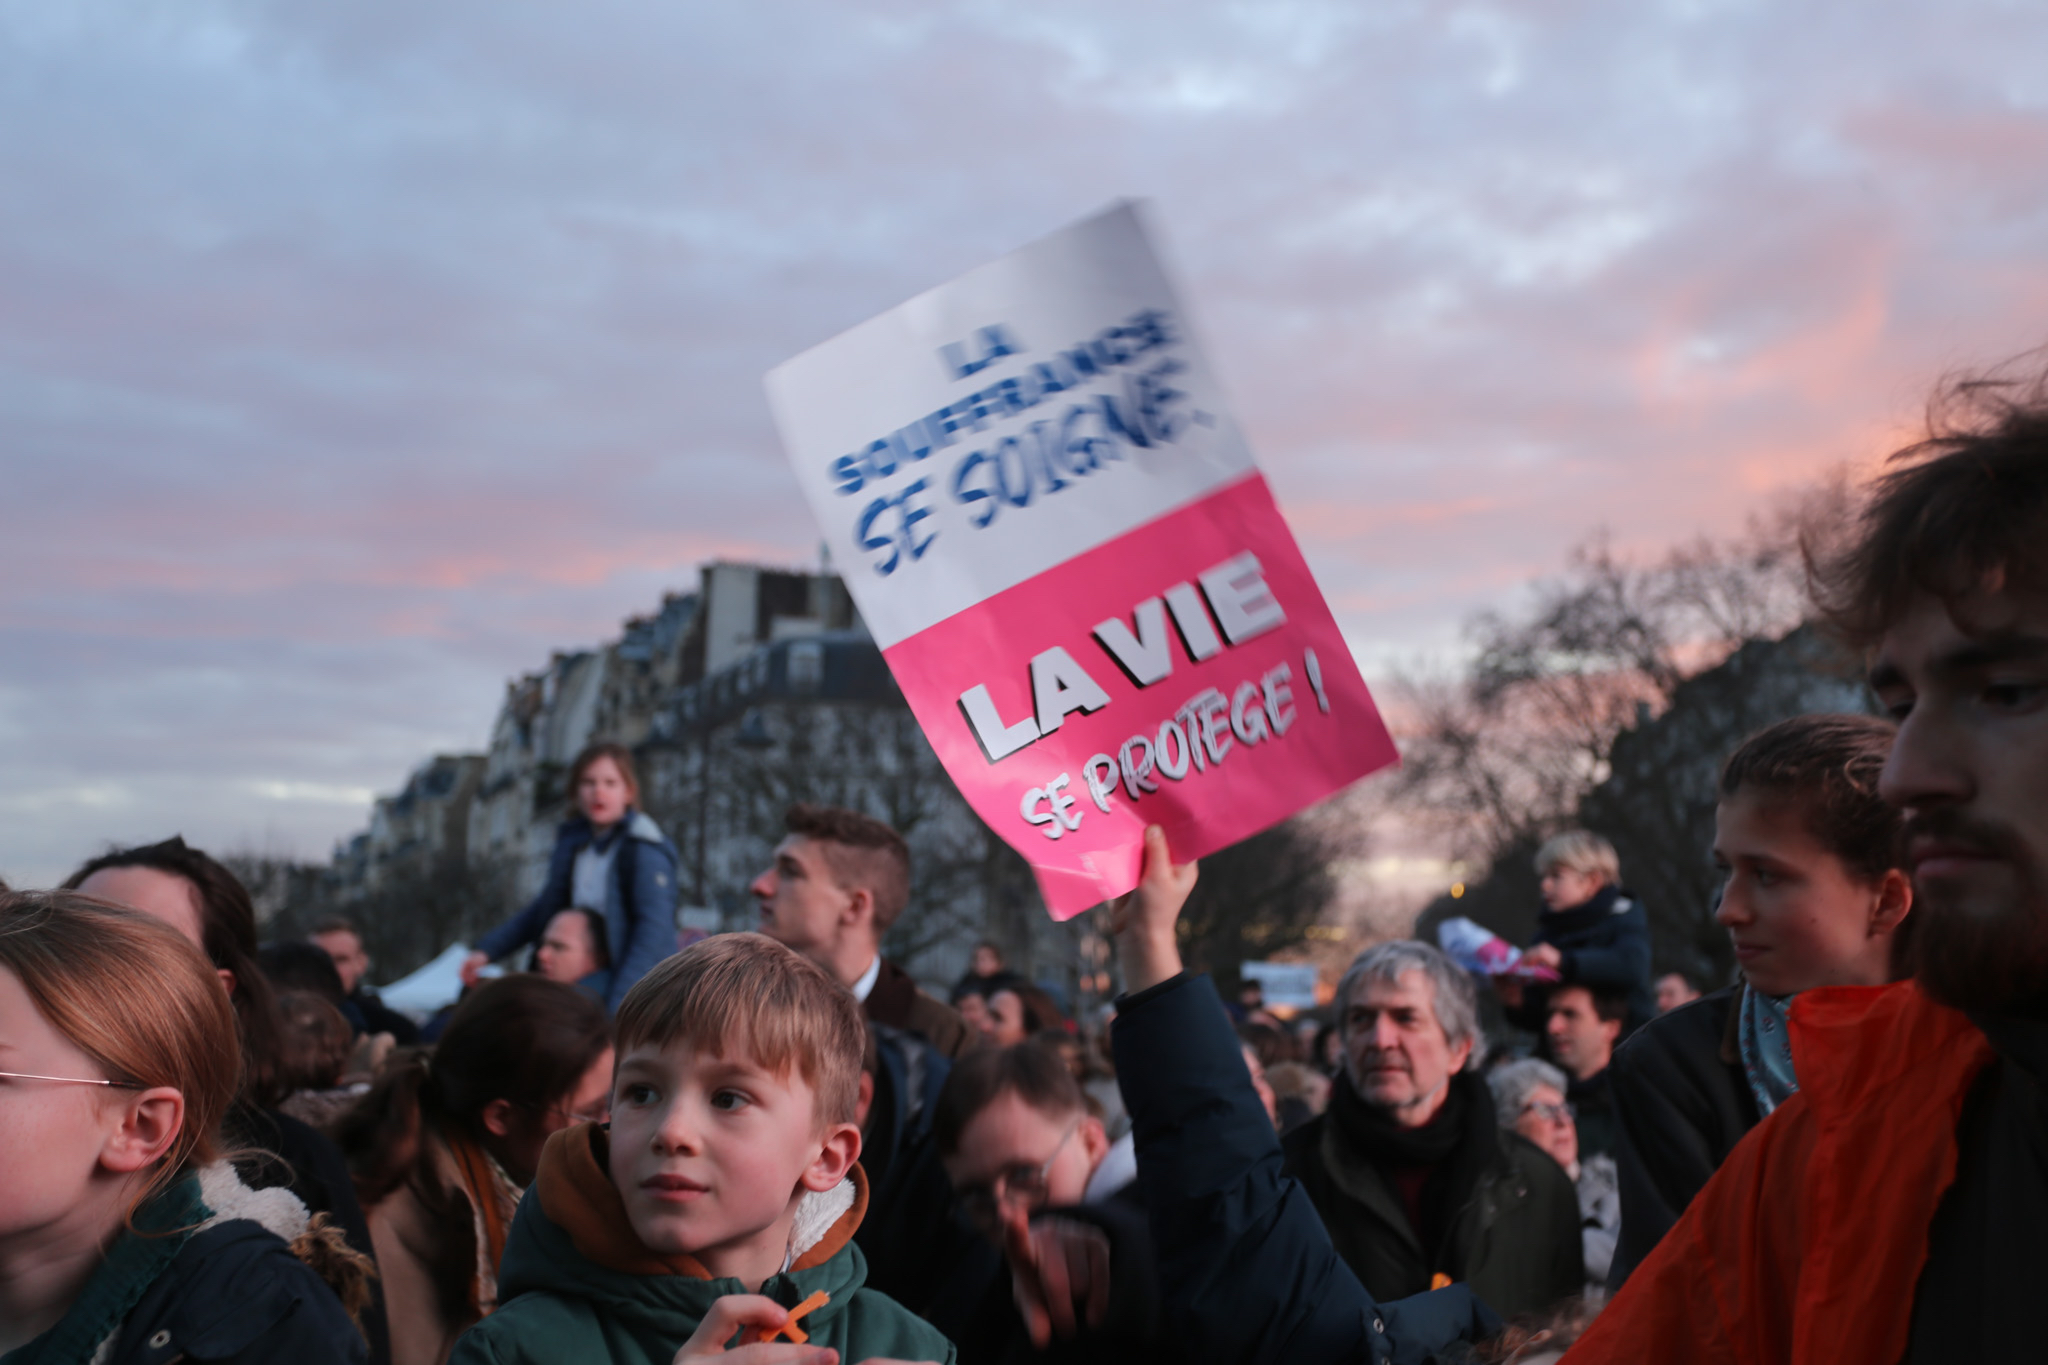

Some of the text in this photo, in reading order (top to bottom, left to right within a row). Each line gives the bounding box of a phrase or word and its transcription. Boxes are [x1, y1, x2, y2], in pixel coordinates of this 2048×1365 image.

[828, 311, 1178, 494] SOUFFRANCE
[938, 322, 1024, 381] LA
[853, 473, 940, 577] SE
[956, 549, 1288, 764] LA VIE
[1020, 772, 1084, 840] SE
[1083, 661, 1298, 815] PROTEGE
